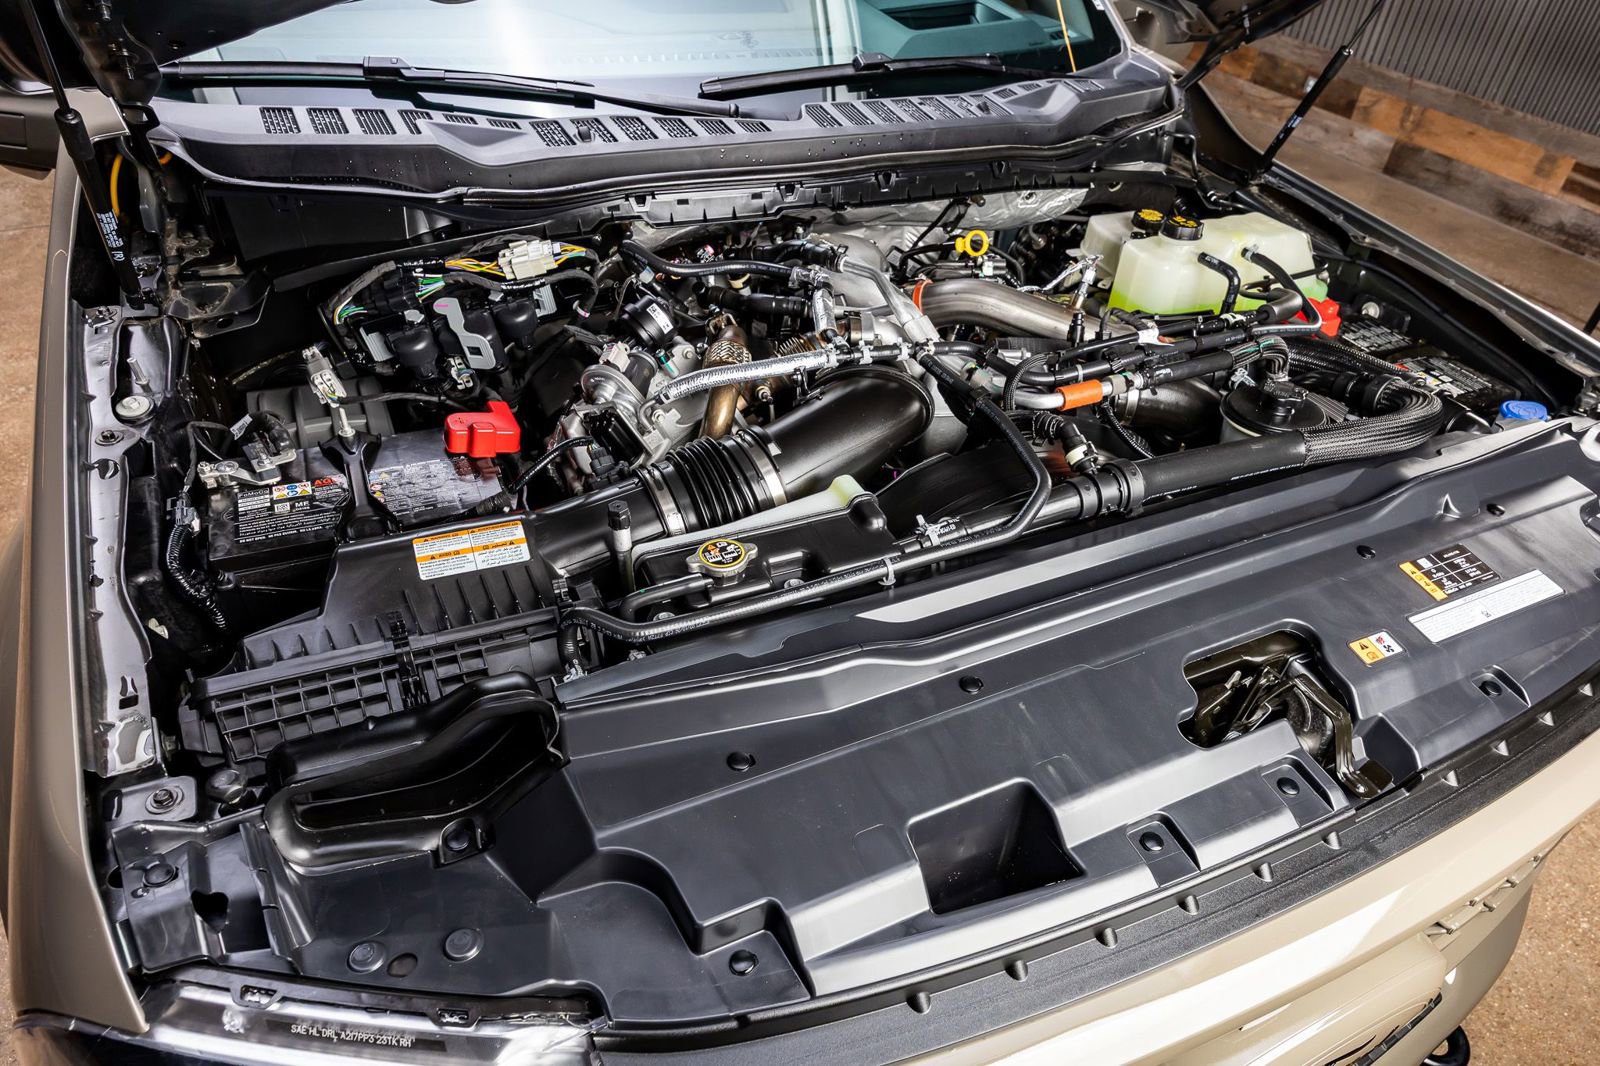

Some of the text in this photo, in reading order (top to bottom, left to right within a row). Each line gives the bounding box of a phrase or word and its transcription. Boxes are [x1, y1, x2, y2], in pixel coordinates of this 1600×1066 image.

[290, 1024, 307, 1035] SAE
[308, 1027, 320, 1037] HL
[321, 1029, 337, 1039] DRL
[399, 1037, 412, 1048] RH
